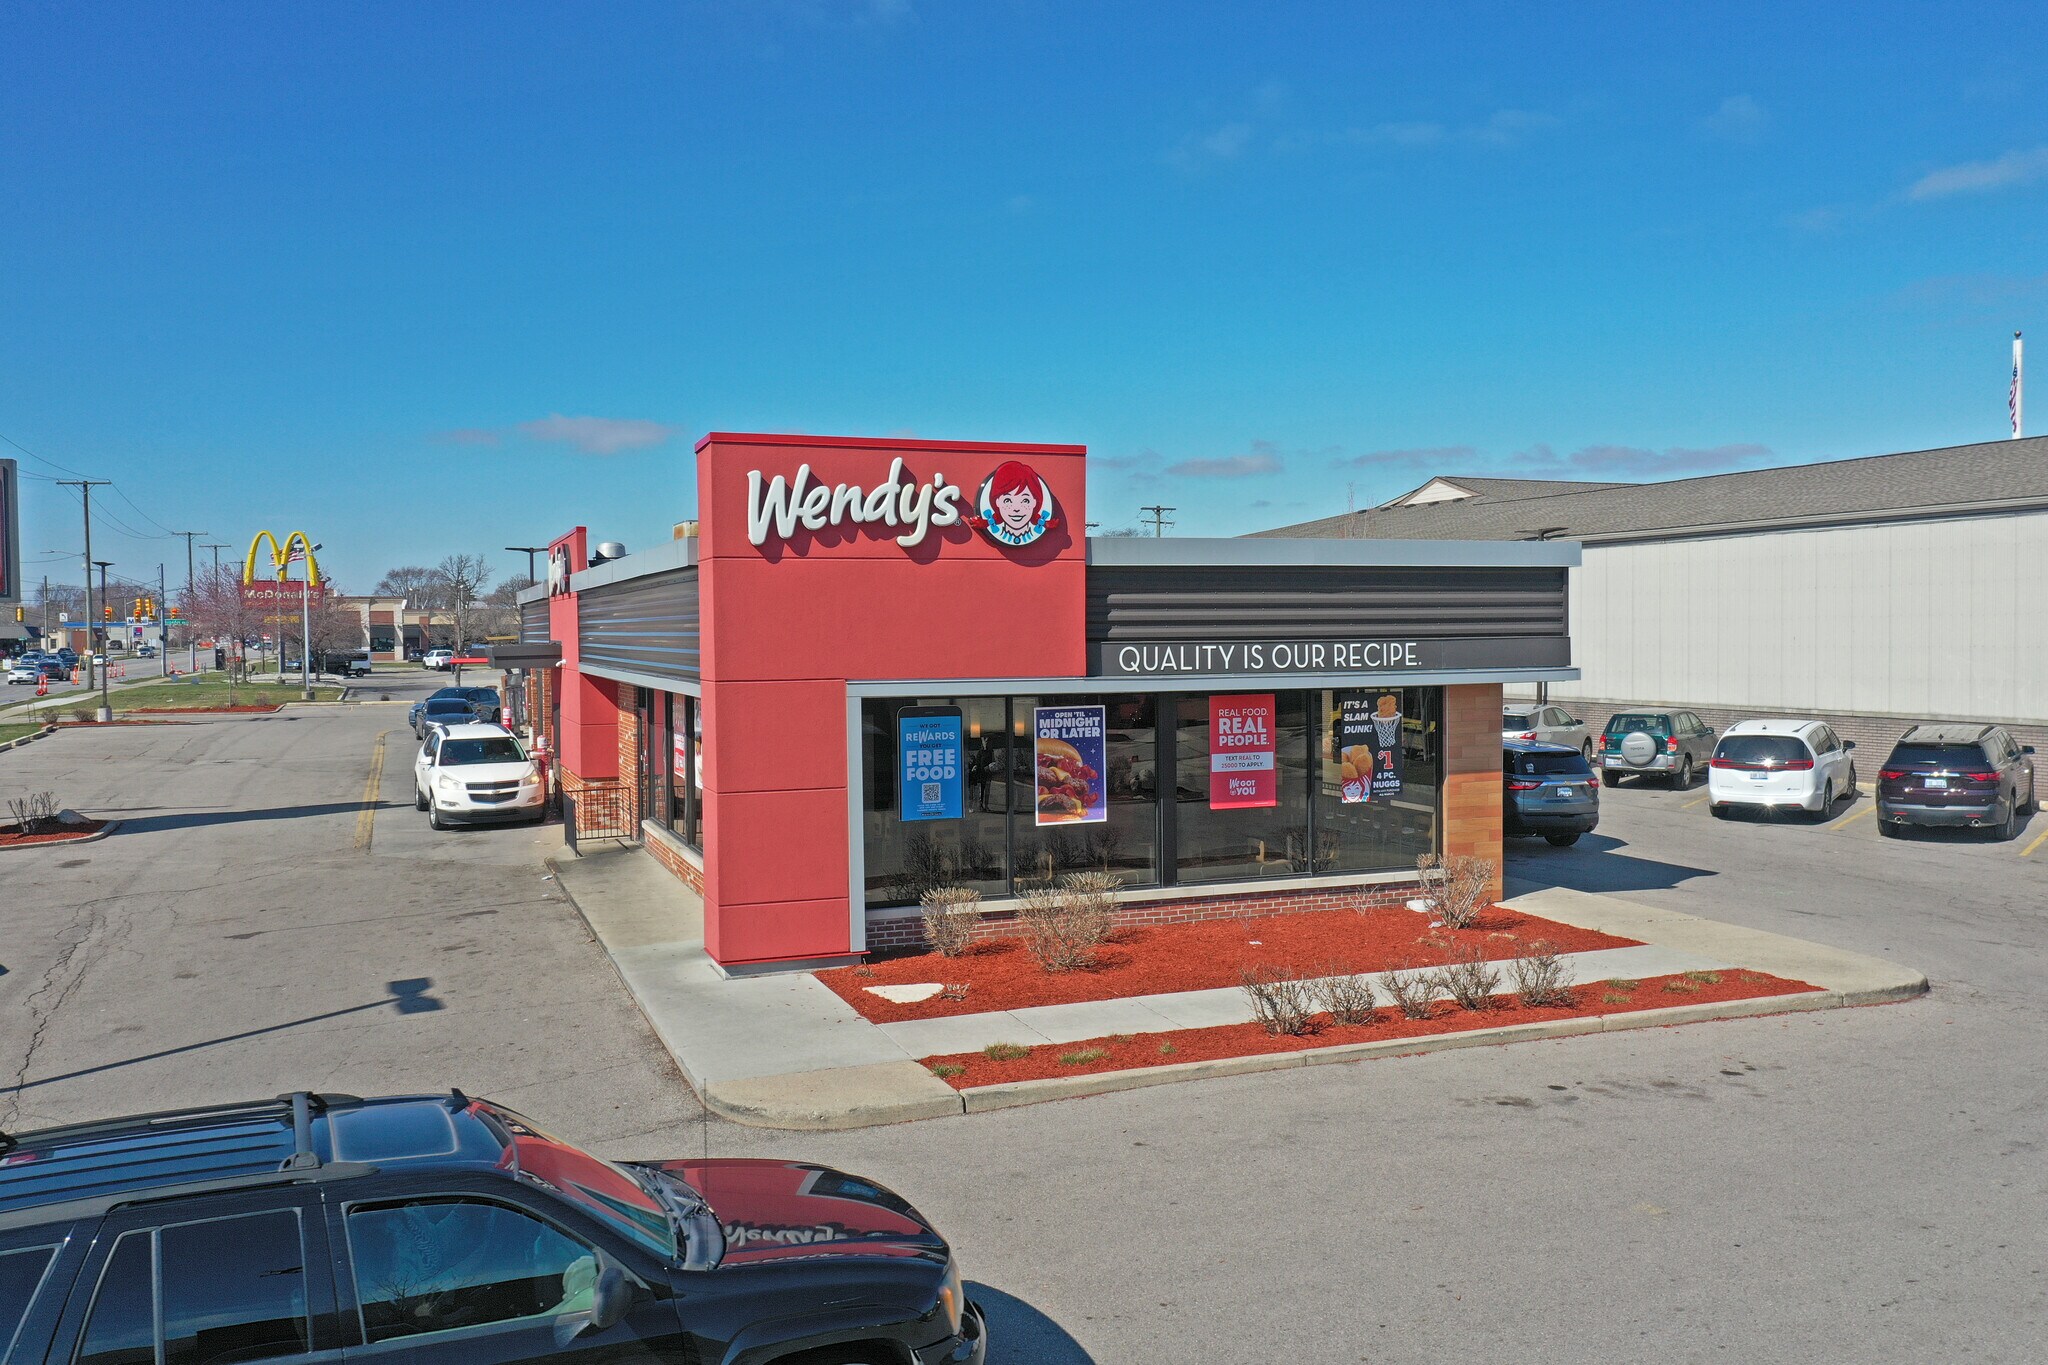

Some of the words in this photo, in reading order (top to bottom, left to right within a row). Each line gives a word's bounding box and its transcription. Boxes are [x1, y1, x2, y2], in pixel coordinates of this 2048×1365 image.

[747, 457, 960, 547] Wendy's
[1118, 645, 1235, 673] QUALITY
[1243, 644, 1264, 669] IS
[1272, 643, 1325, 669] OUR
[1333, 642, 1422, 668] RECIPE.
[1343, 700, 1360, 709] IT'S
[1360, 700, 1368, 709] A
[1218, 709, 1240, 717] REAL
[1242, 707, 1269, 716] FOOD.
[1343, 712, 1369, 722] SLAM
[1039, 717, 1101, 729] MIDNIGHT
[1218, 717, 1267, 734] REAL
[1343, 724, 1373, 734] DUNK!
[905, 729, 956, 743] REWARDS
[1039, 729, 1060, 739] OR
[1061, 727, 1101, 739] LATER
[1218, 734, 1270, 747] PEOPLE.
[906, 748, 956, 767] FREE
[1378, 750, 1394, 769] $1
[906, 766, 956, 781] FOOD
[1376, 772, 1382, 780] 4
[1383, 771, 1396, 780] PC.
[1372, 779, 1401, 789] NUGGS
[1236, 787, 1256, 796] YOU
